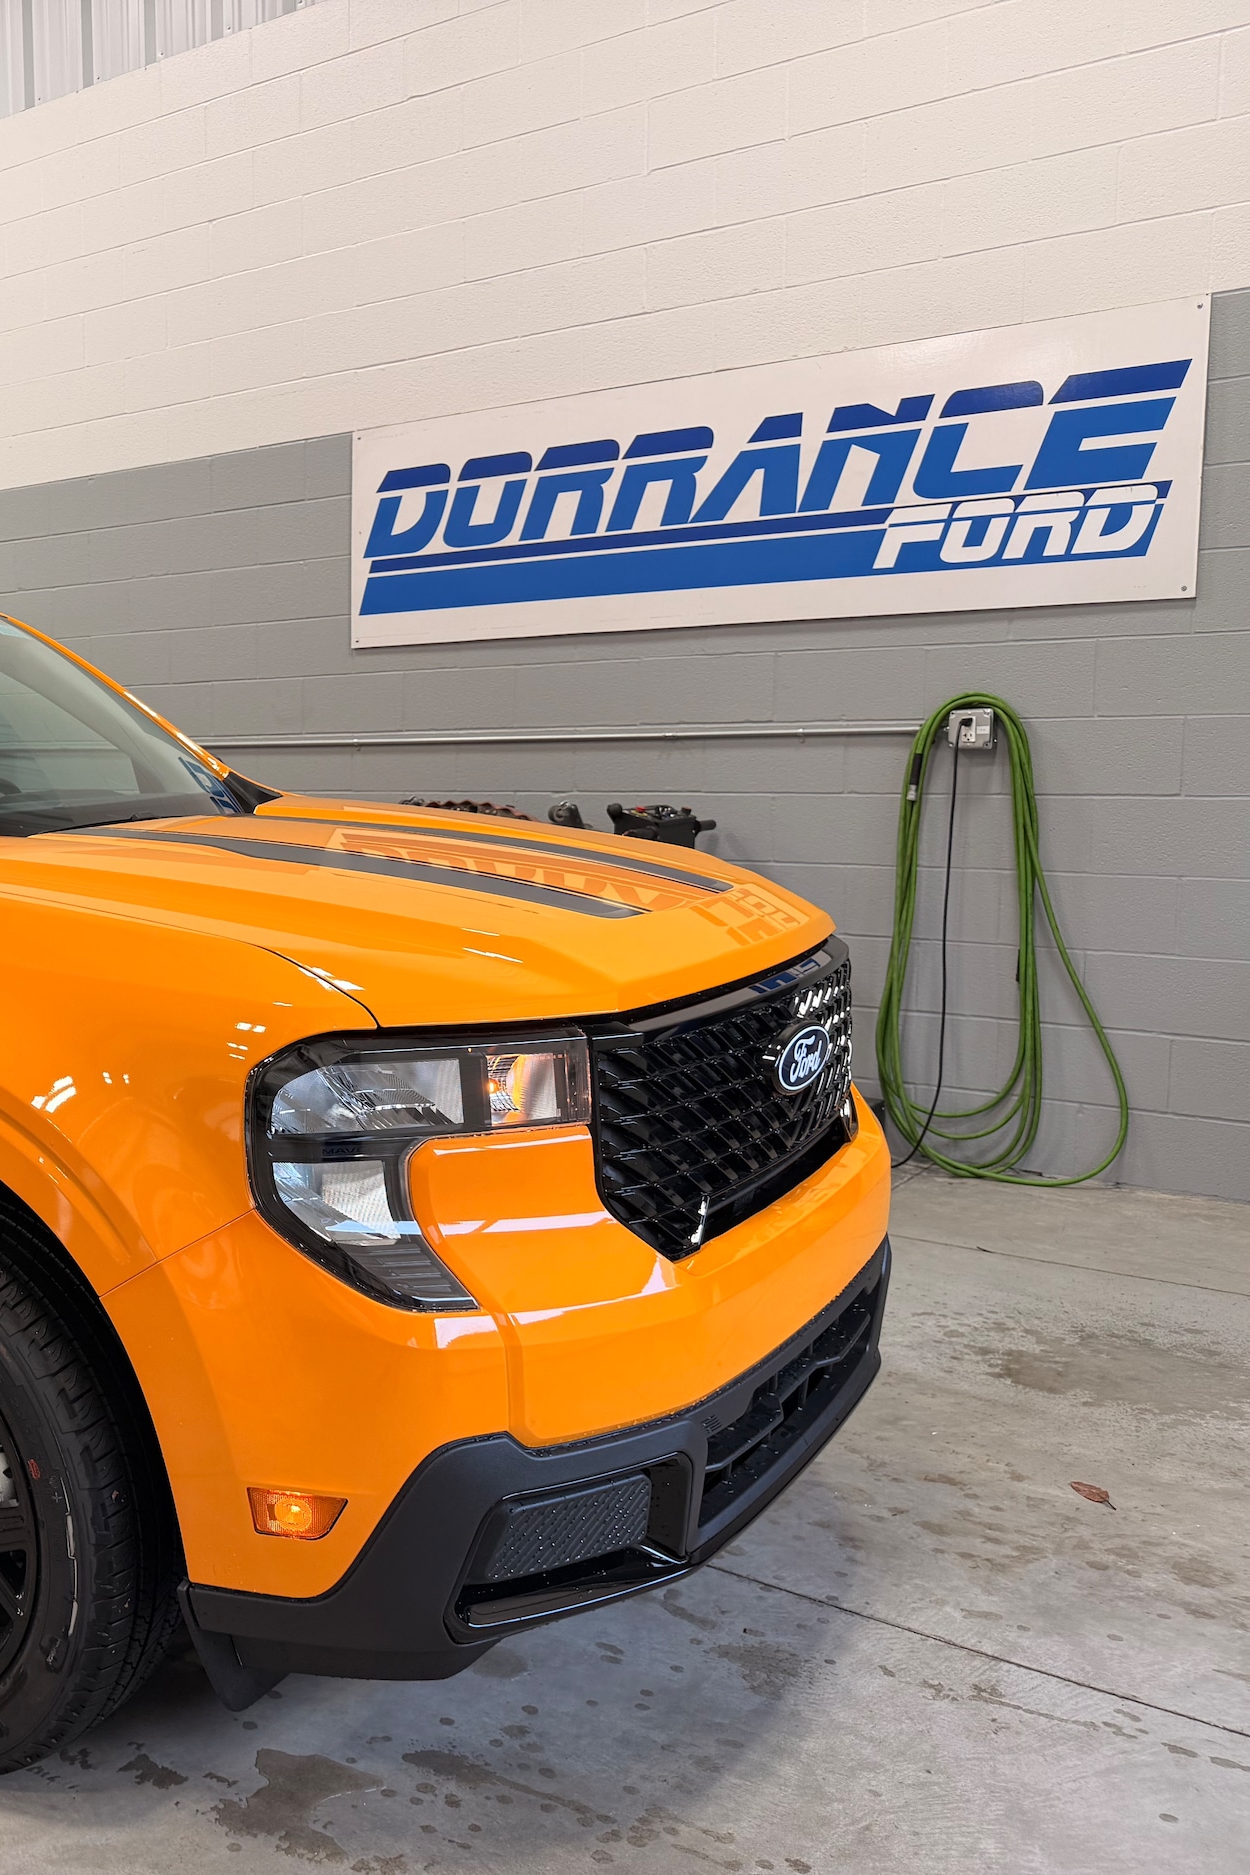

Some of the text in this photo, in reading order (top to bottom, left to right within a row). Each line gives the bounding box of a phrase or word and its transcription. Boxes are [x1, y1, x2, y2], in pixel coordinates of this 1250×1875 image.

[363, 358, 1193, 559] DORRANCE
[872, 484, 1160, 570] FORD
[789, 1035, 823, 1083] Ford
